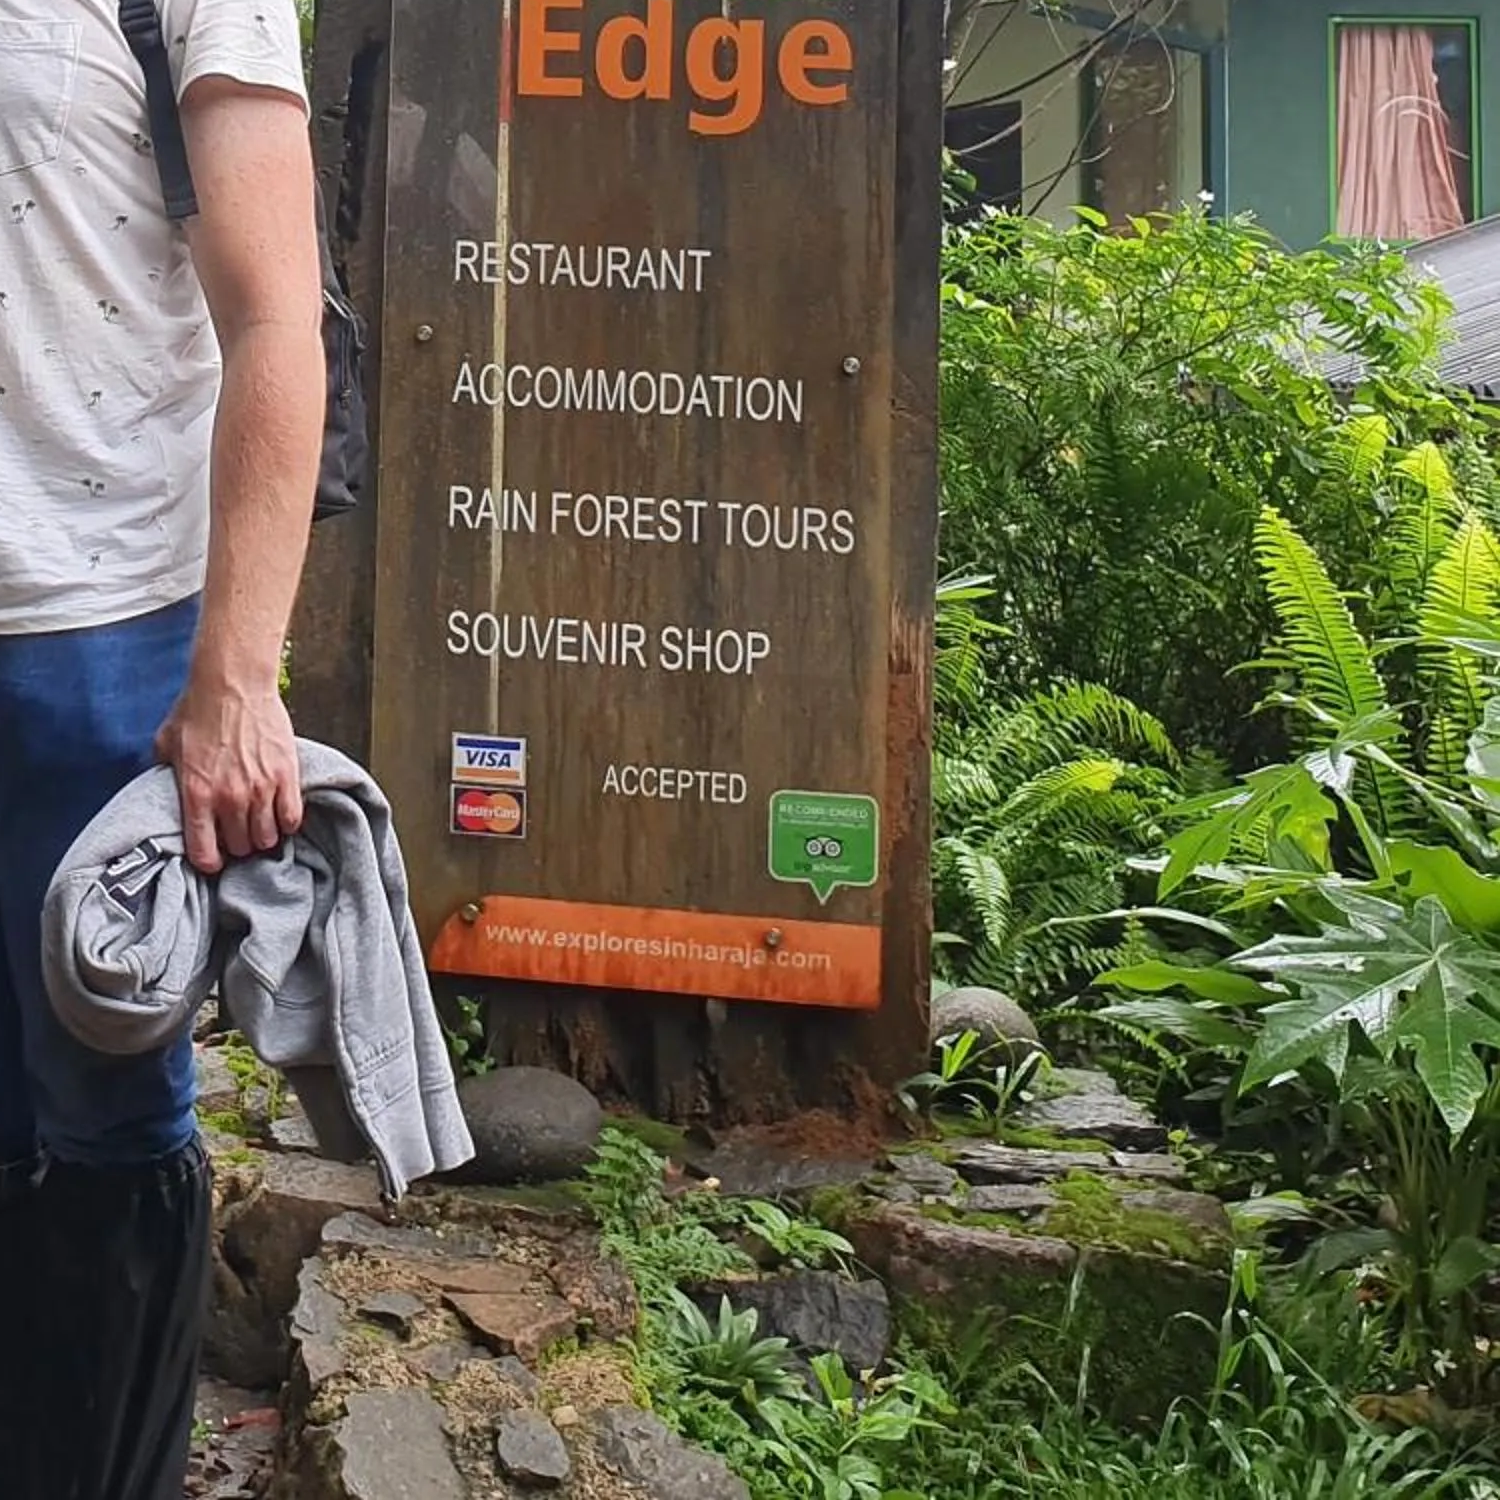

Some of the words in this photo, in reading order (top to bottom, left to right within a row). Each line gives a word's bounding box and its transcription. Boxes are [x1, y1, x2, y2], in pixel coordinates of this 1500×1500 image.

[453, 240, 712, 292] RESTAURANT
[452, 361, 802, 423] ACCOMMODATION
[449, 486, 536, 533] RAIN
[551, 492, 707, 544] FOREST
[719, 501, 855, 554] TOURS
[447, 610, 647, 667] SOUVENIR
[659, 626, 771, 675] SHOP
[466, 750, 511, 768] VISA
[602, 764, 747, 804] ACCEPTED
